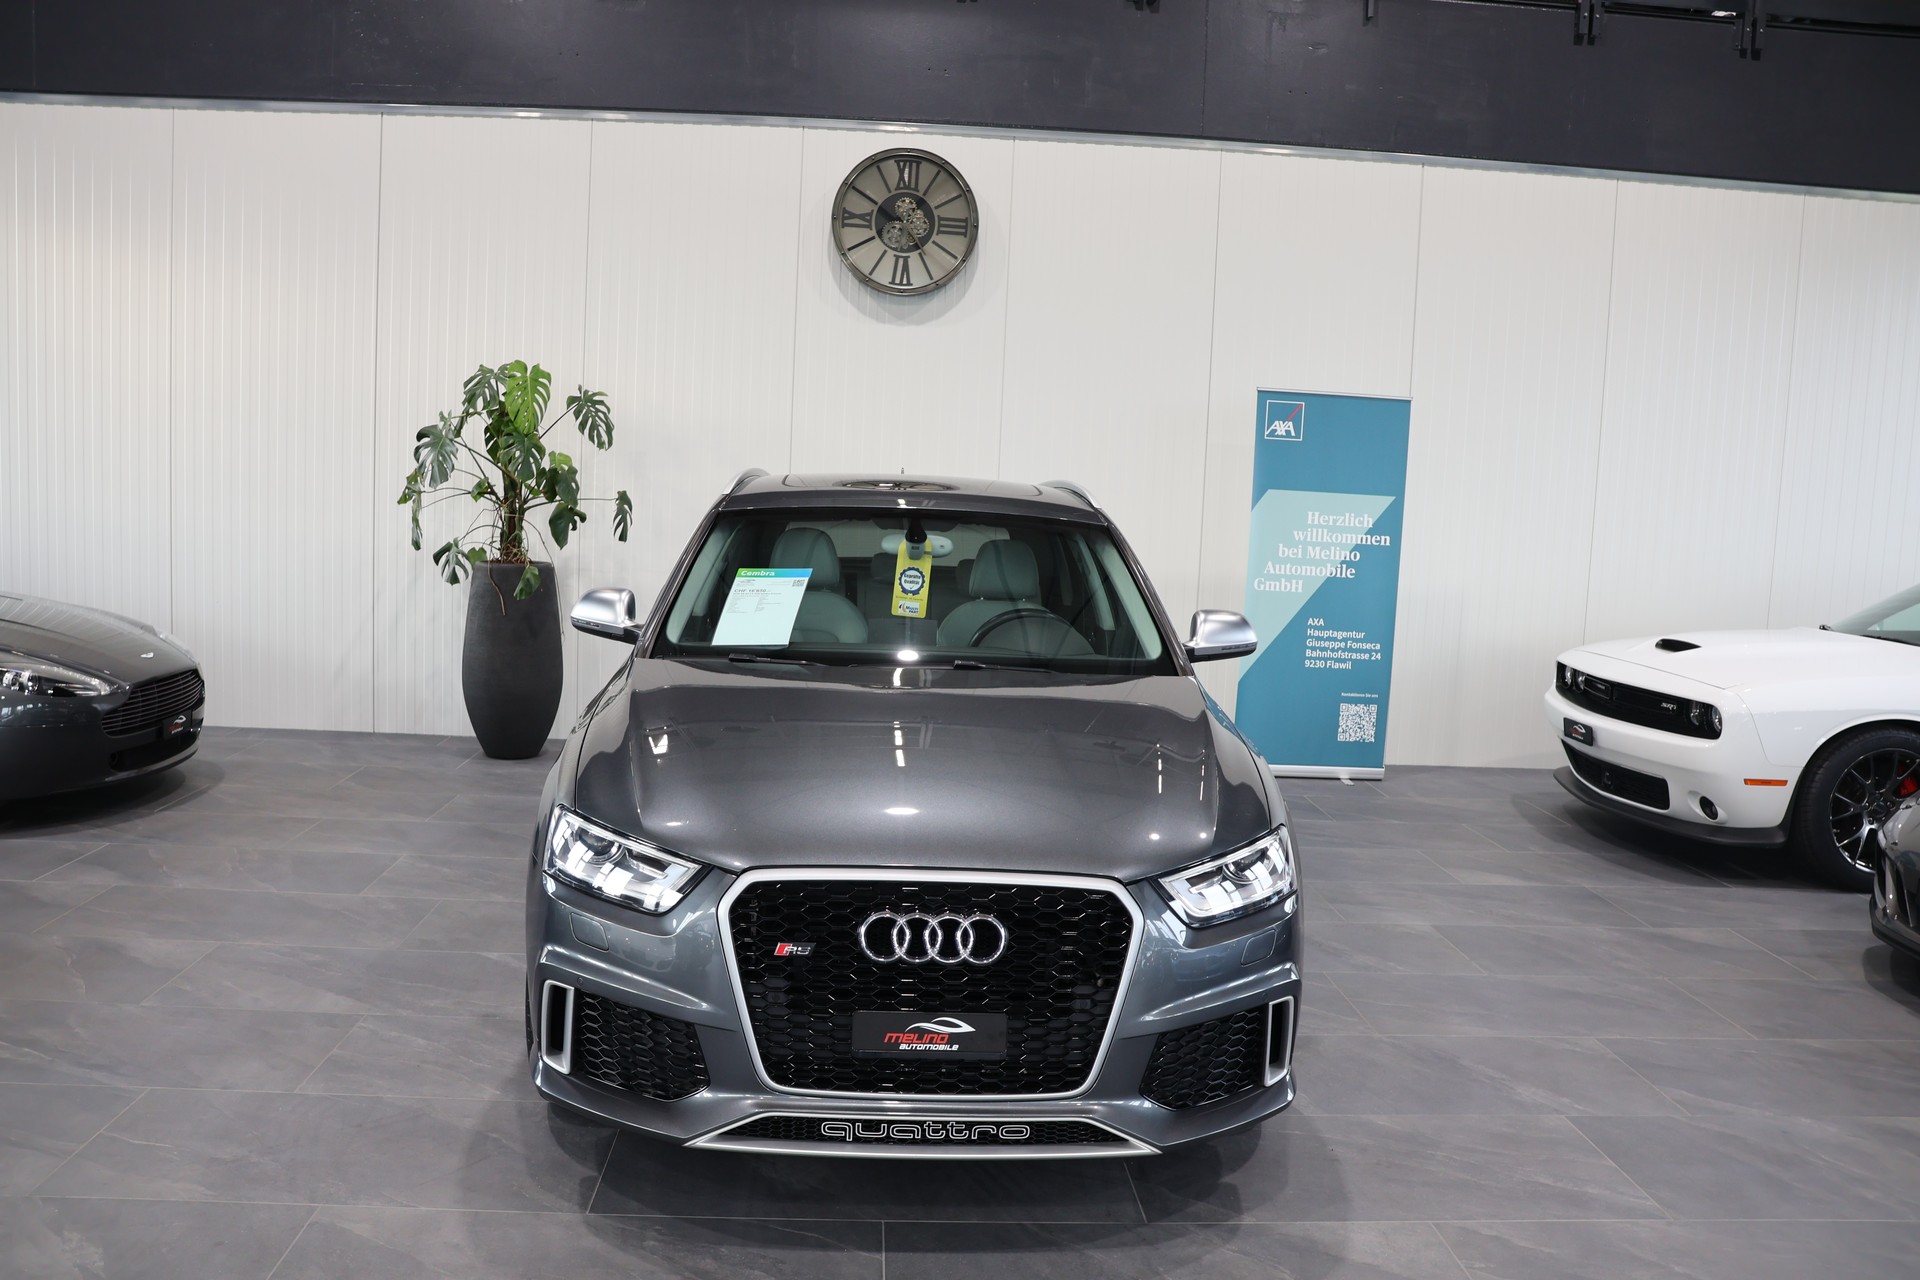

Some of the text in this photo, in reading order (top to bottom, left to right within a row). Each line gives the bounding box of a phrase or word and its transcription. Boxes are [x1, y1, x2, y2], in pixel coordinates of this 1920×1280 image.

[1265, 420, 1296, 436] AXA
[1307, 511, 1373, 528] Herzlich
[1293, 528, 1391, 546] willkommen
[1278, 543, 1360, 562] bei Melino
[1264, 561, 1356, 578] Automobile
[1253, 578, 1304, 593] GmbH
[1307, 617, 1325, 627] AXA
[1307, 628, 1365, 639] Hauptagentur
[1306, 638, 1381, 650] Giuseppe Fonseca
[1305, 649, 1381, 661] Bahnhofstrasse 24
[1304, 660, 1352, 670] 9230 Flawil
[821, 1121, 1031, 1142] quattro
